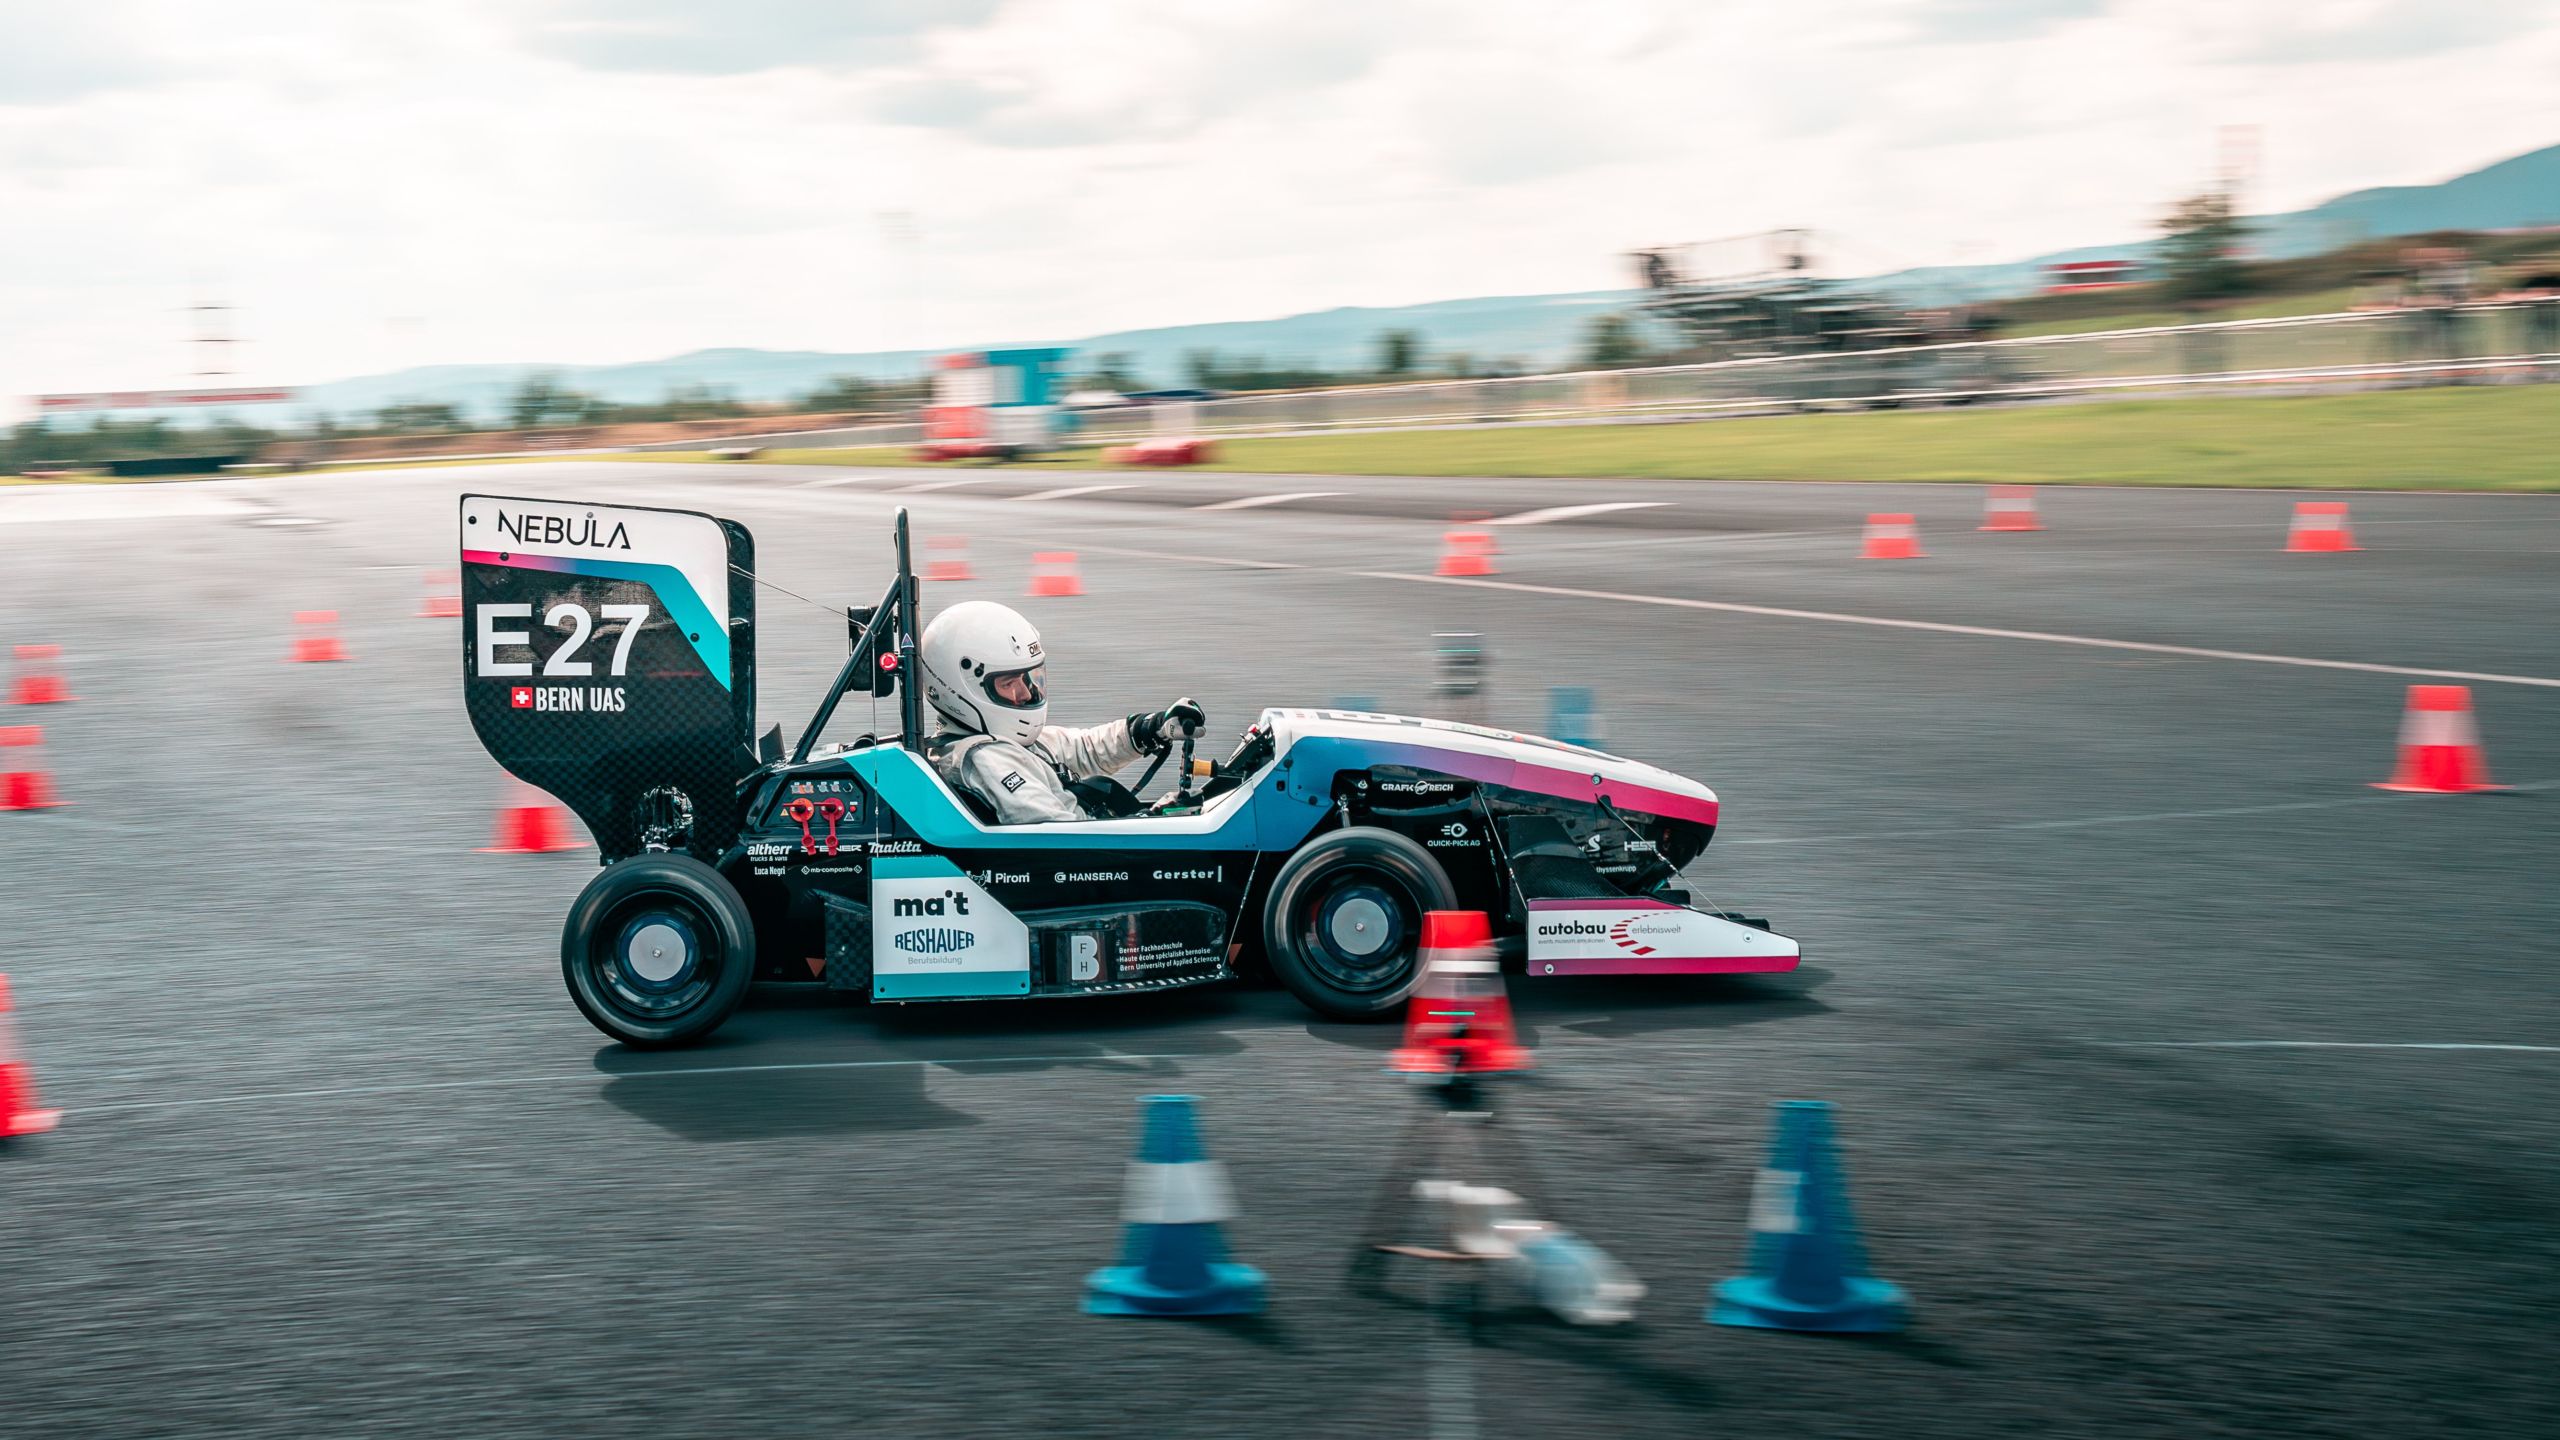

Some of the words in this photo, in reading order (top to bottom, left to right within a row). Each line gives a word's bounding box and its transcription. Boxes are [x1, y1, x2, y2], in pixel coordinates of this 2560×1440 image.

[498, 509, 631, 550] NEBULA
[476, 603, 650, 678] E27
[535, 687, 584, 712] BERN
[590, 687, 626, 712] UAS
[747, 843, 792, 855] altherr
[754, 866, 769, 875] Luca
[769, 866, 786, 877] Negri
[1152, 869, 1215, 879] Gerster
[1538, 920, 1606, 936] autobau
[1632, 923, 1682, 935] erlebniswelt
[895, 928, 975, 953] REISHAUER
[1119, 946, 1140, 955] Berner
[1141, 941, 1183, 953] Fachhochschule
[908, 956, 963, 965] Berufsbildung
[1119, 955, 1138, 963] Haute
[1185, 947, 1211, 956] bernoise
[1120, 964, 1135, 972] Bern
[1135, 961, 1166, 971] University
[1173, 957, 1193, 967] Applied
[1193, 955, 1220, 964] Sciences
